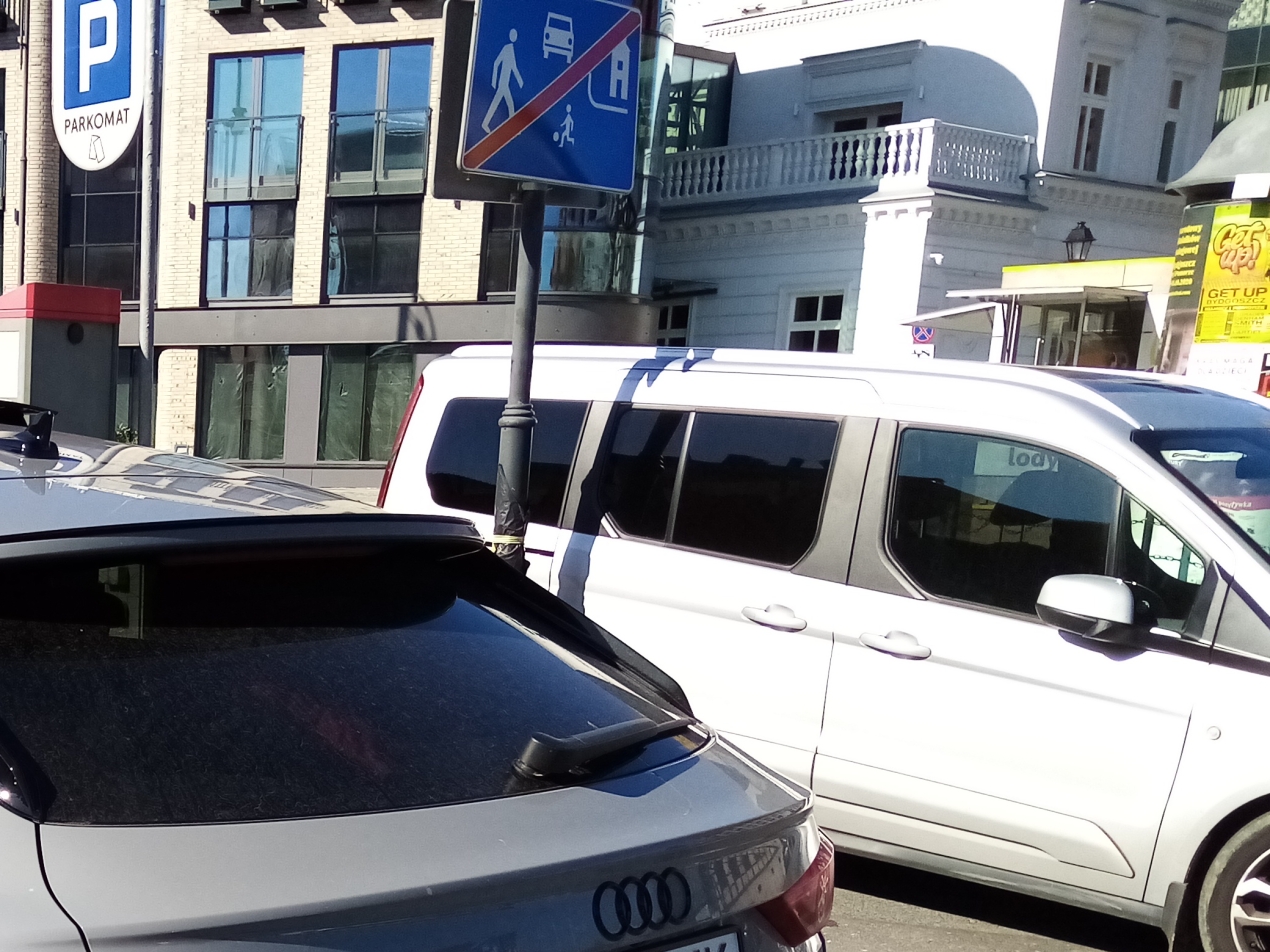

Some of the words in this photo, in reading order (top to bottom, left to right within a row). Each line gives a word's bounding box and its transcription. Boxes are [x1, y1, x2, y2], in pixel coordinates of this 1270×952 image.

[79, 0, 118, 93] P
[64, 108, 130, 135] PARKOMAT
[1208, 288, 1240, 298] GET
[1243, 287, 1268, 297] UP
